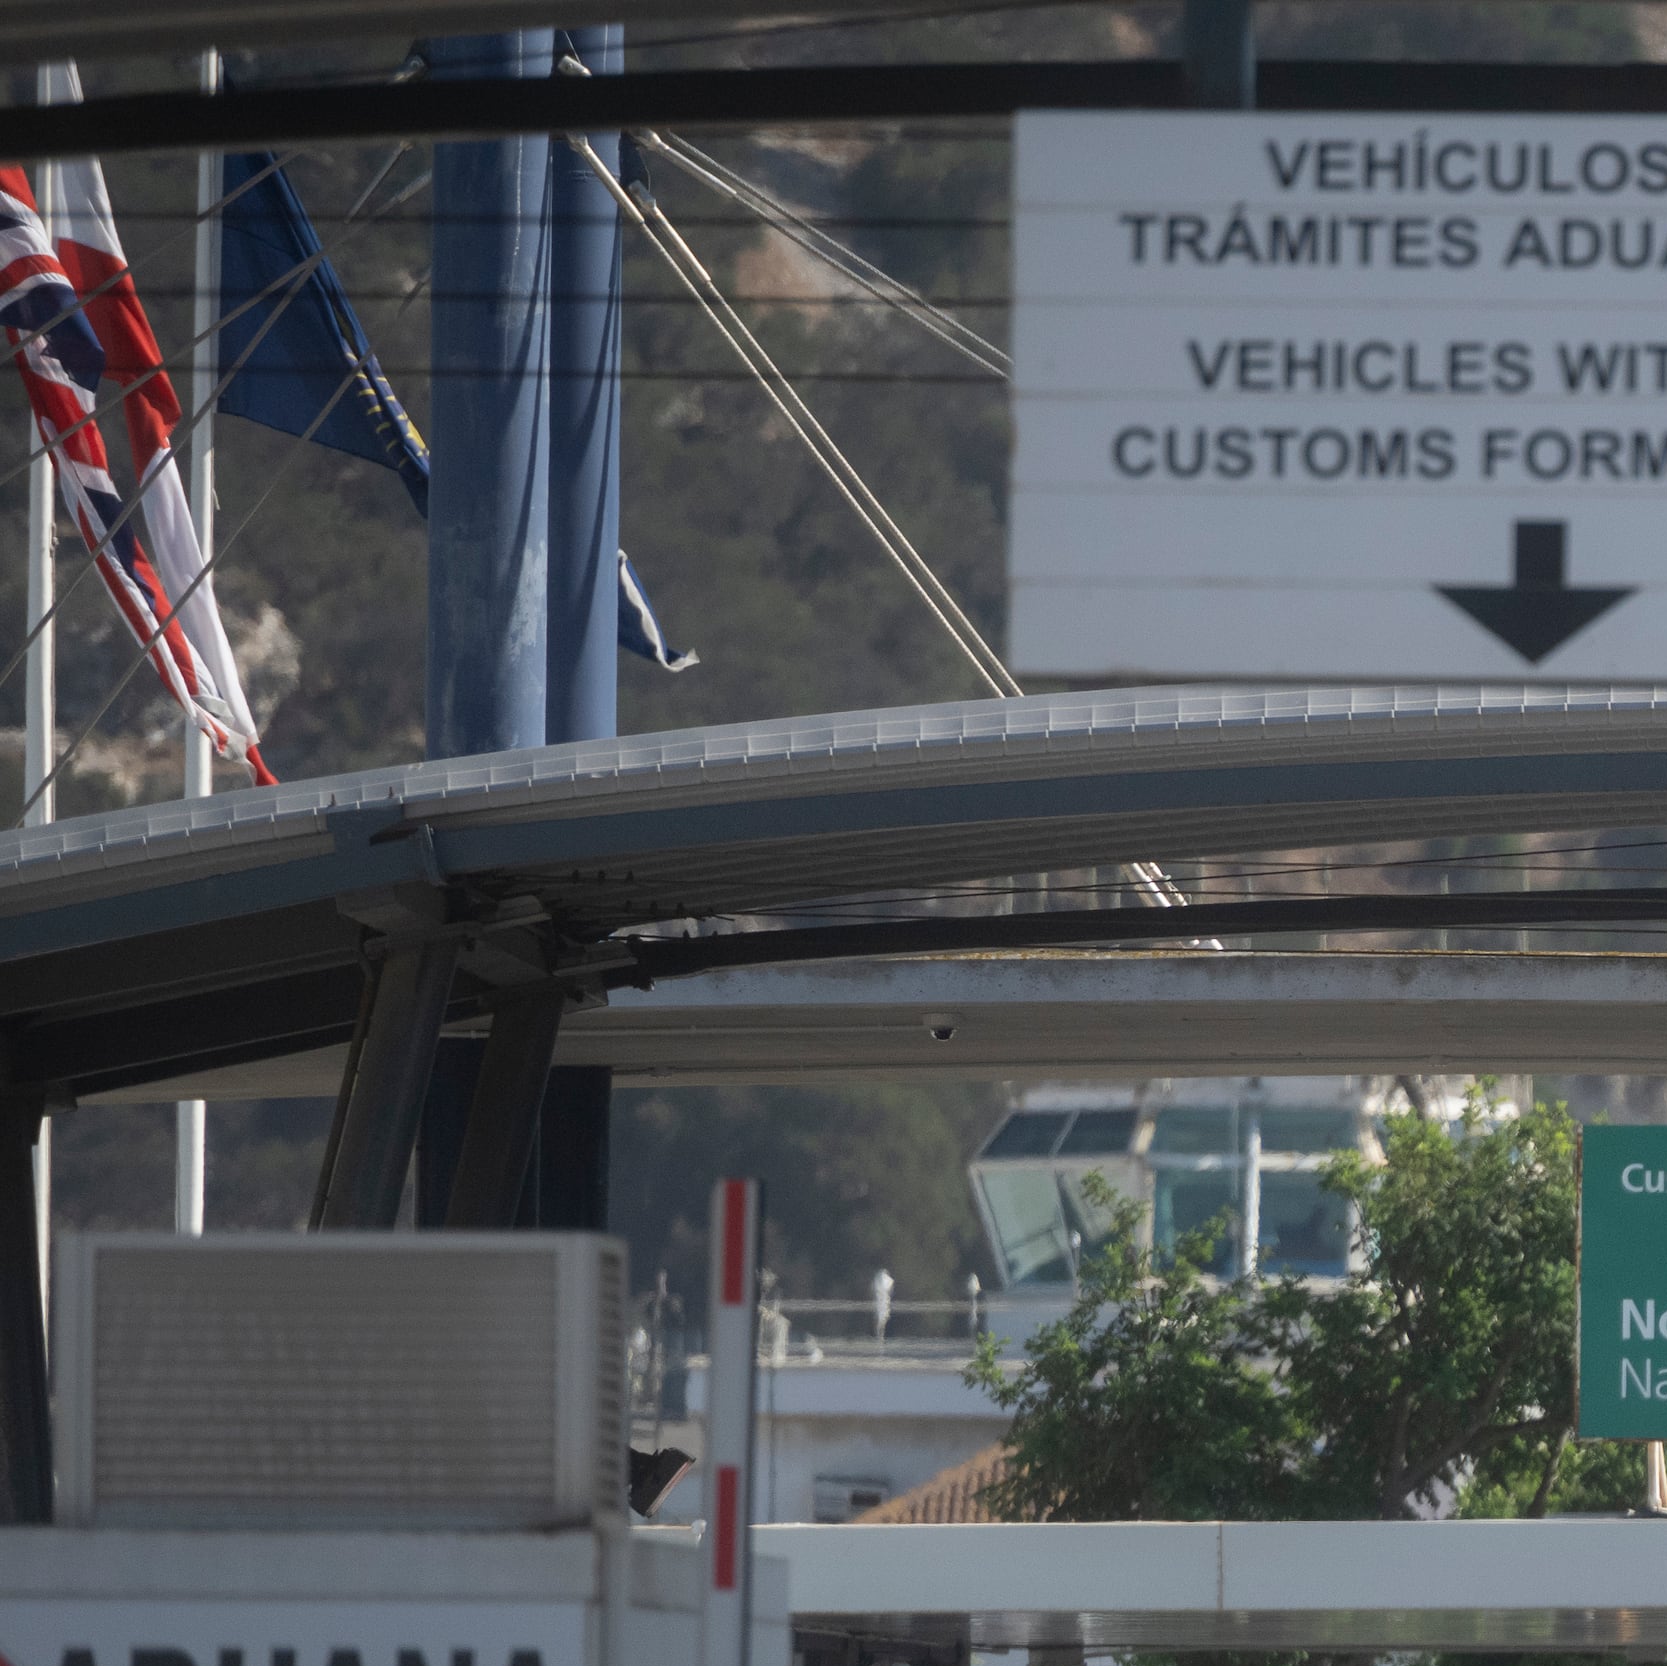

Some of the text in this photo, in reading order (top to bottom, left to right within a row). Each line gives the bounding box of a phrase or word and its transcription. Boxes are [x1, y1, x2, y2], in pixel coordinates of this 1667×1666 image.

[1119, 200, 1480, 269] TRÁMITES
[1184, 341, 1533, 394] VEHICLES
[1111, 427, 1457, 481] CUSTOMS
